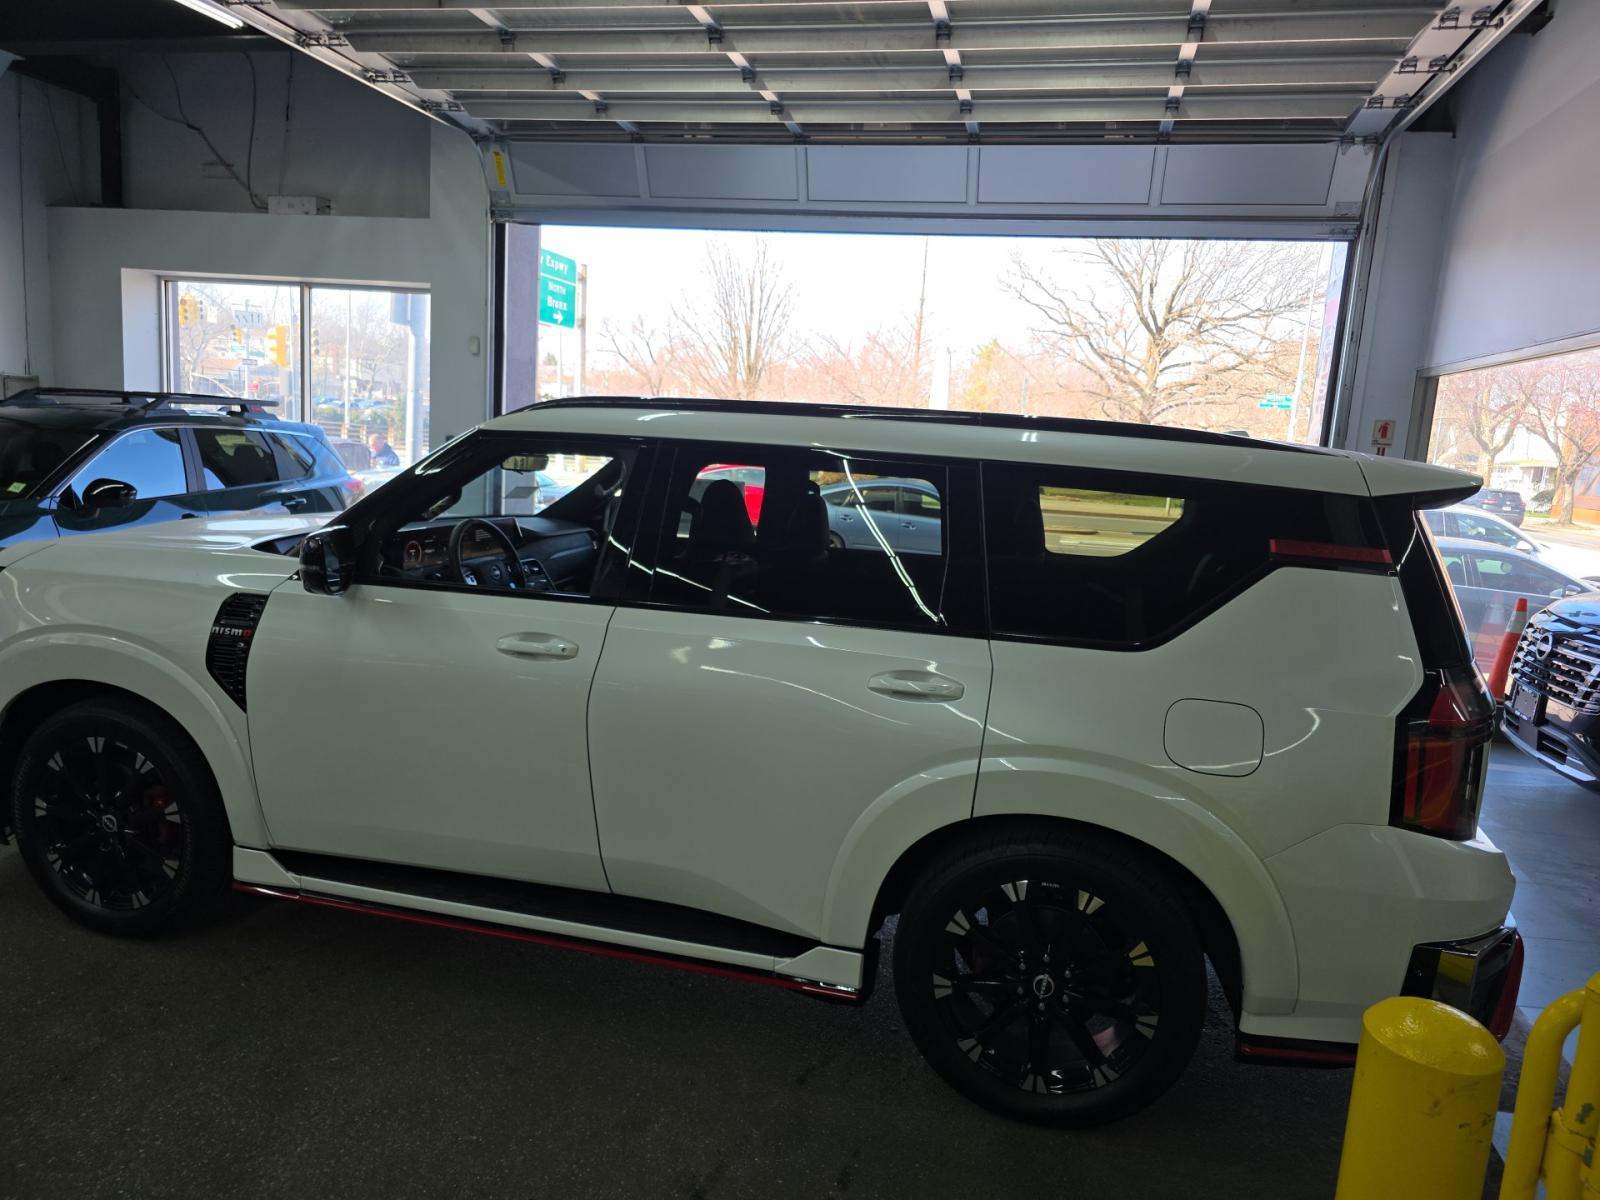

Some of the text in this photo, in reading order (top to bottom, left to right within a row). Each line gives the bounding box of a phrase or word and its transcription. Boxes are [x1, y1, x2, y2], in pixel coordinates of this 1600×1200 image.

[546, 255, 568, 274] Expwy
[547, 296, 568, 311] Bronx
[212, 626, 251, 636] nismo
